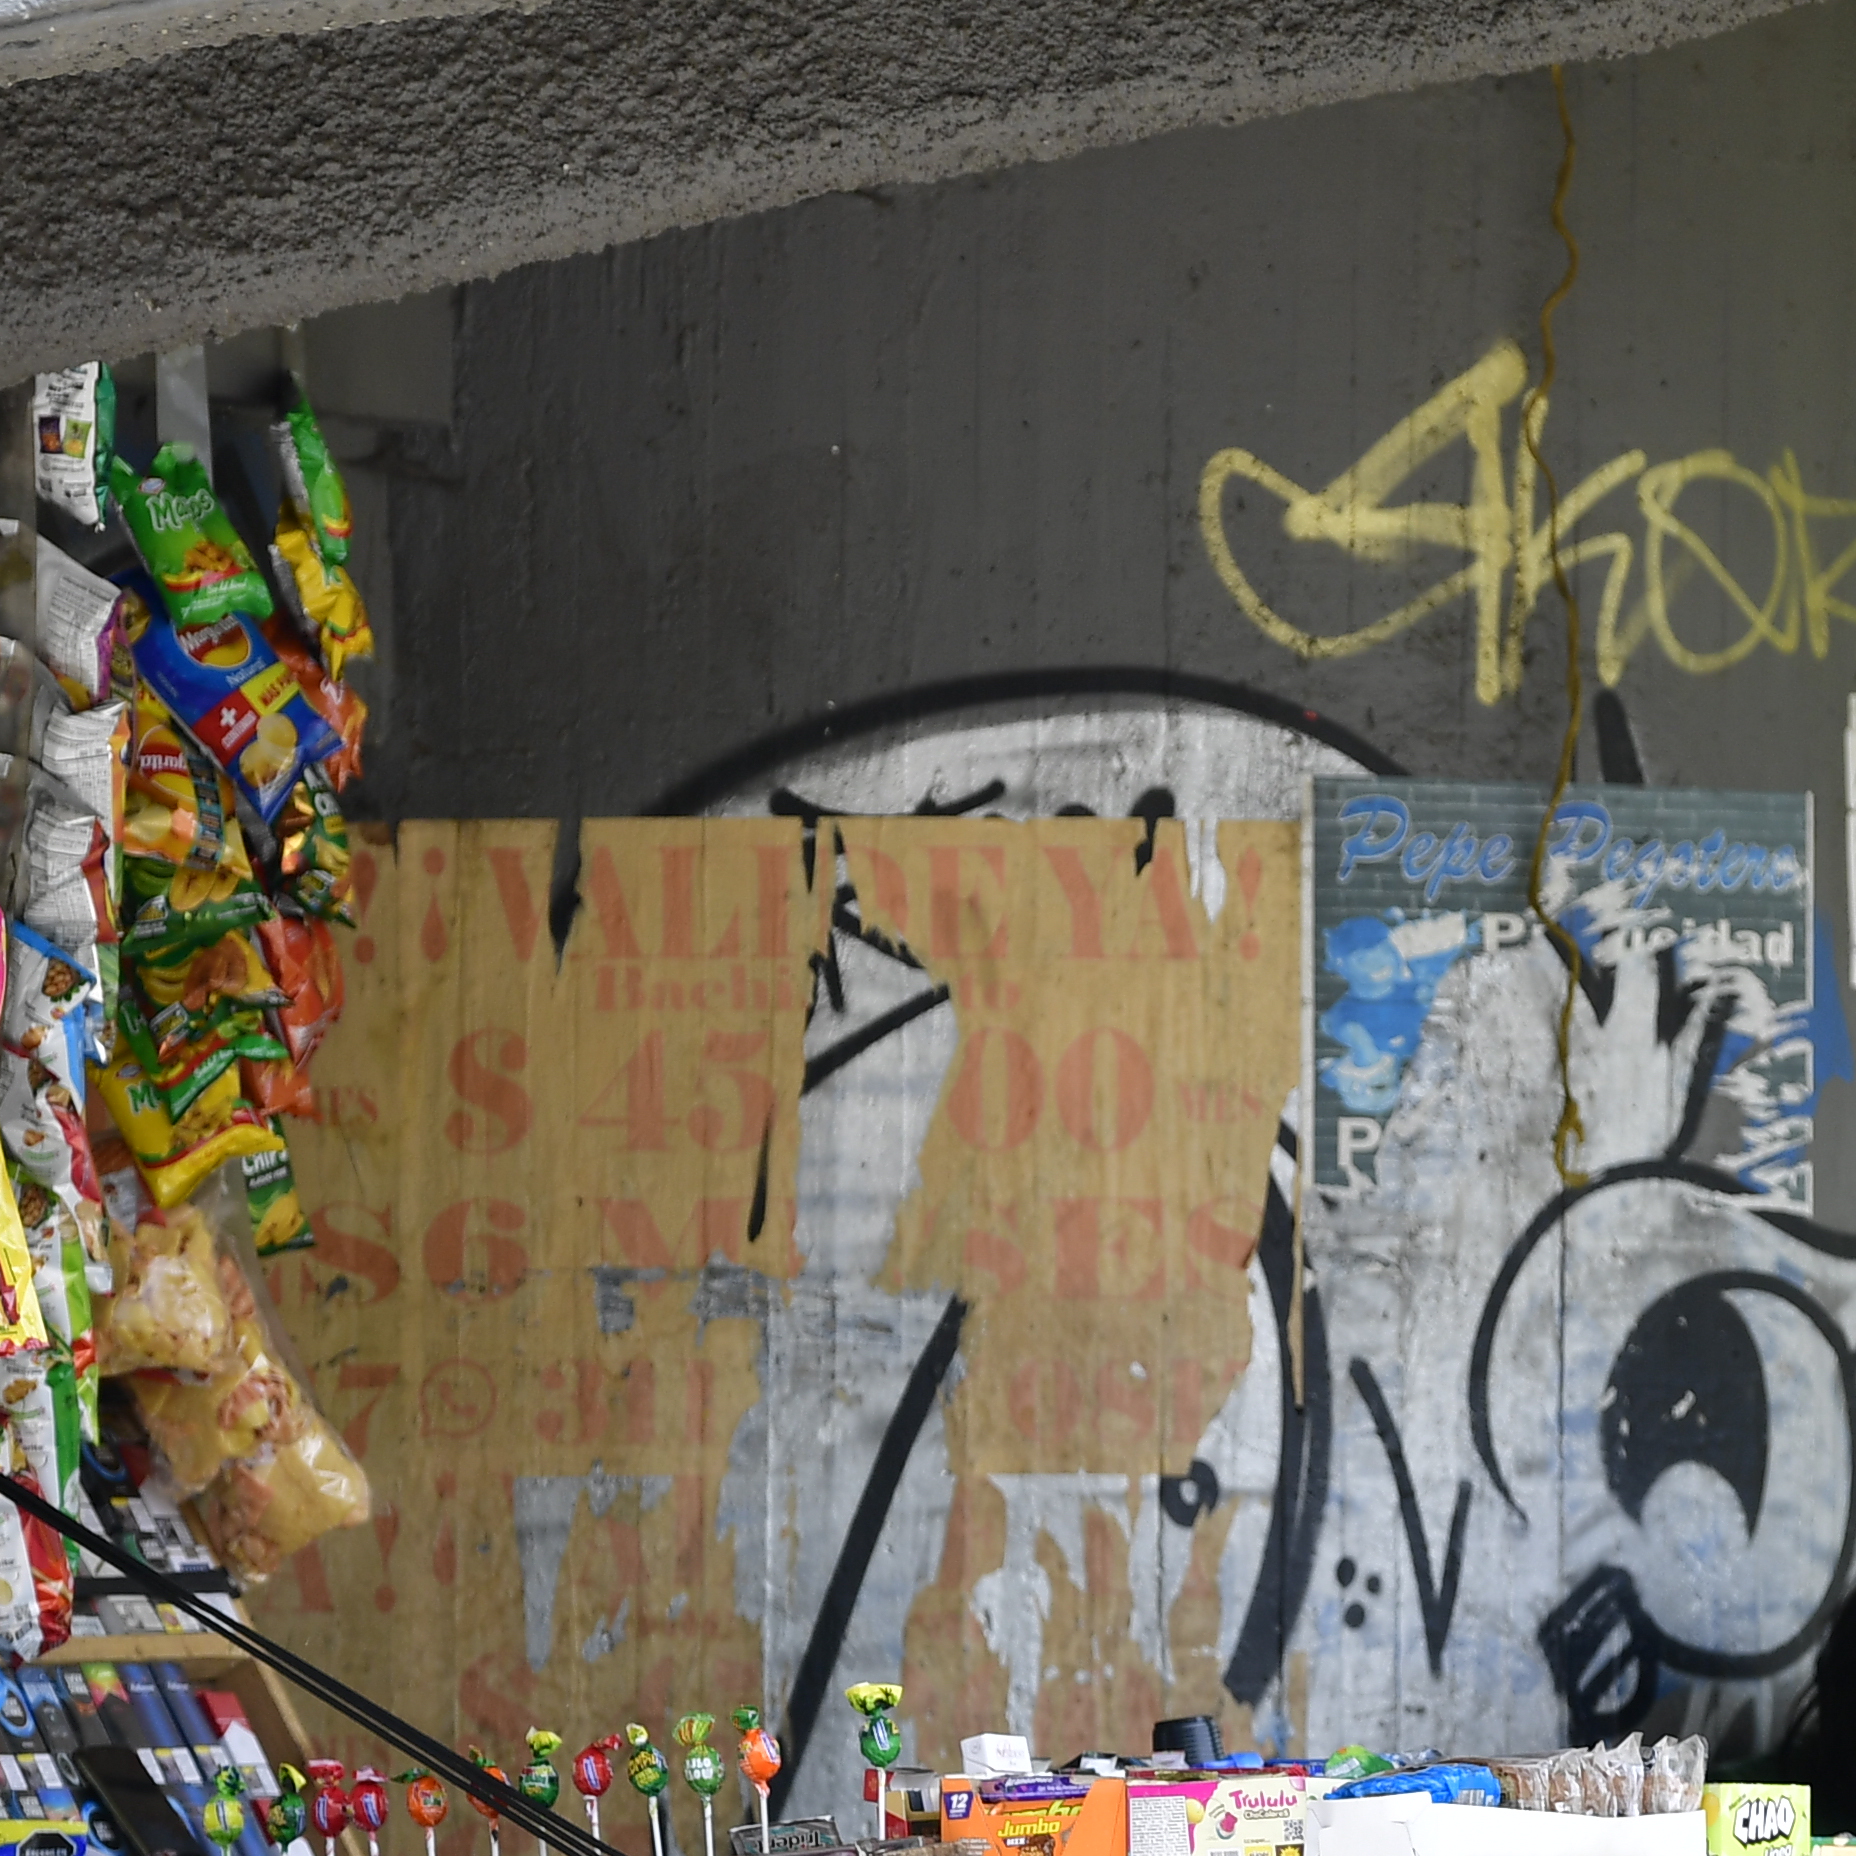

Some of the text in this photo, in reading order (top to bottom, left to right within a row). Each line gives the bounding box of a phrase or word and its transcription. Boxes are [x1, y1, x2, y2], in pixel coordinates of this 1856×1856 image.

[1336, 794, 1516, 901] Pepe
[950, 1793, 968, 1809] 12
[1230, 1789, 1298, 1810] Trululu
[997, 1820, 1062, 1838] Jumbo
[1734, 1795, 1796, 1846] CHAO
